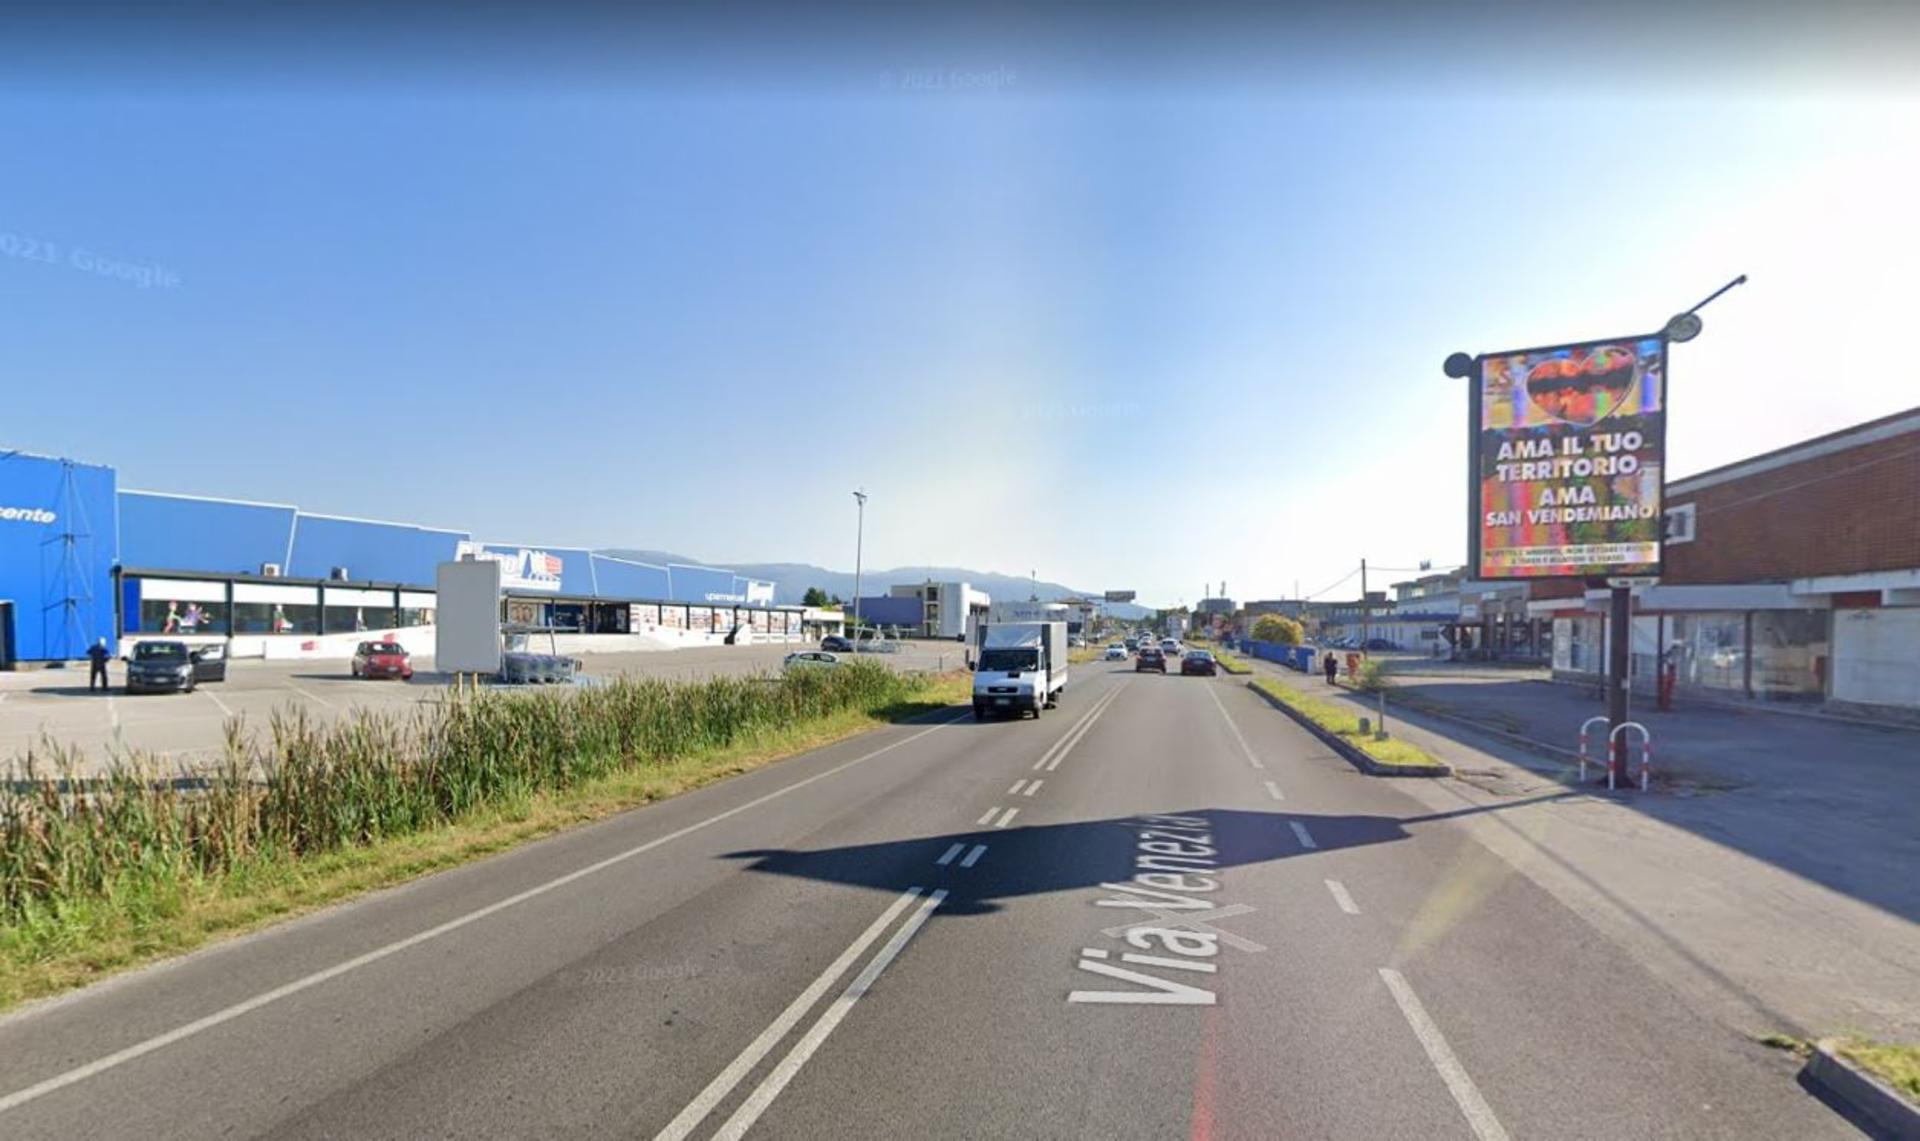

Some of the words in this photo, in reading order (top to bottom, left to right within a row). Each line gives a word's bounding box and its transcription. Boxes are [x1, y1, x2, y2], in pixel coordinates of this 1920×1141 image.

[1497, 438, 1553, 460] AMA
[1562, 435, 1584, 455] IL
[1590, 431, 1642, 452] TUO
[1539, 485, 1596, 506] AMA
[1486, 510, 1522, 527] SAN
